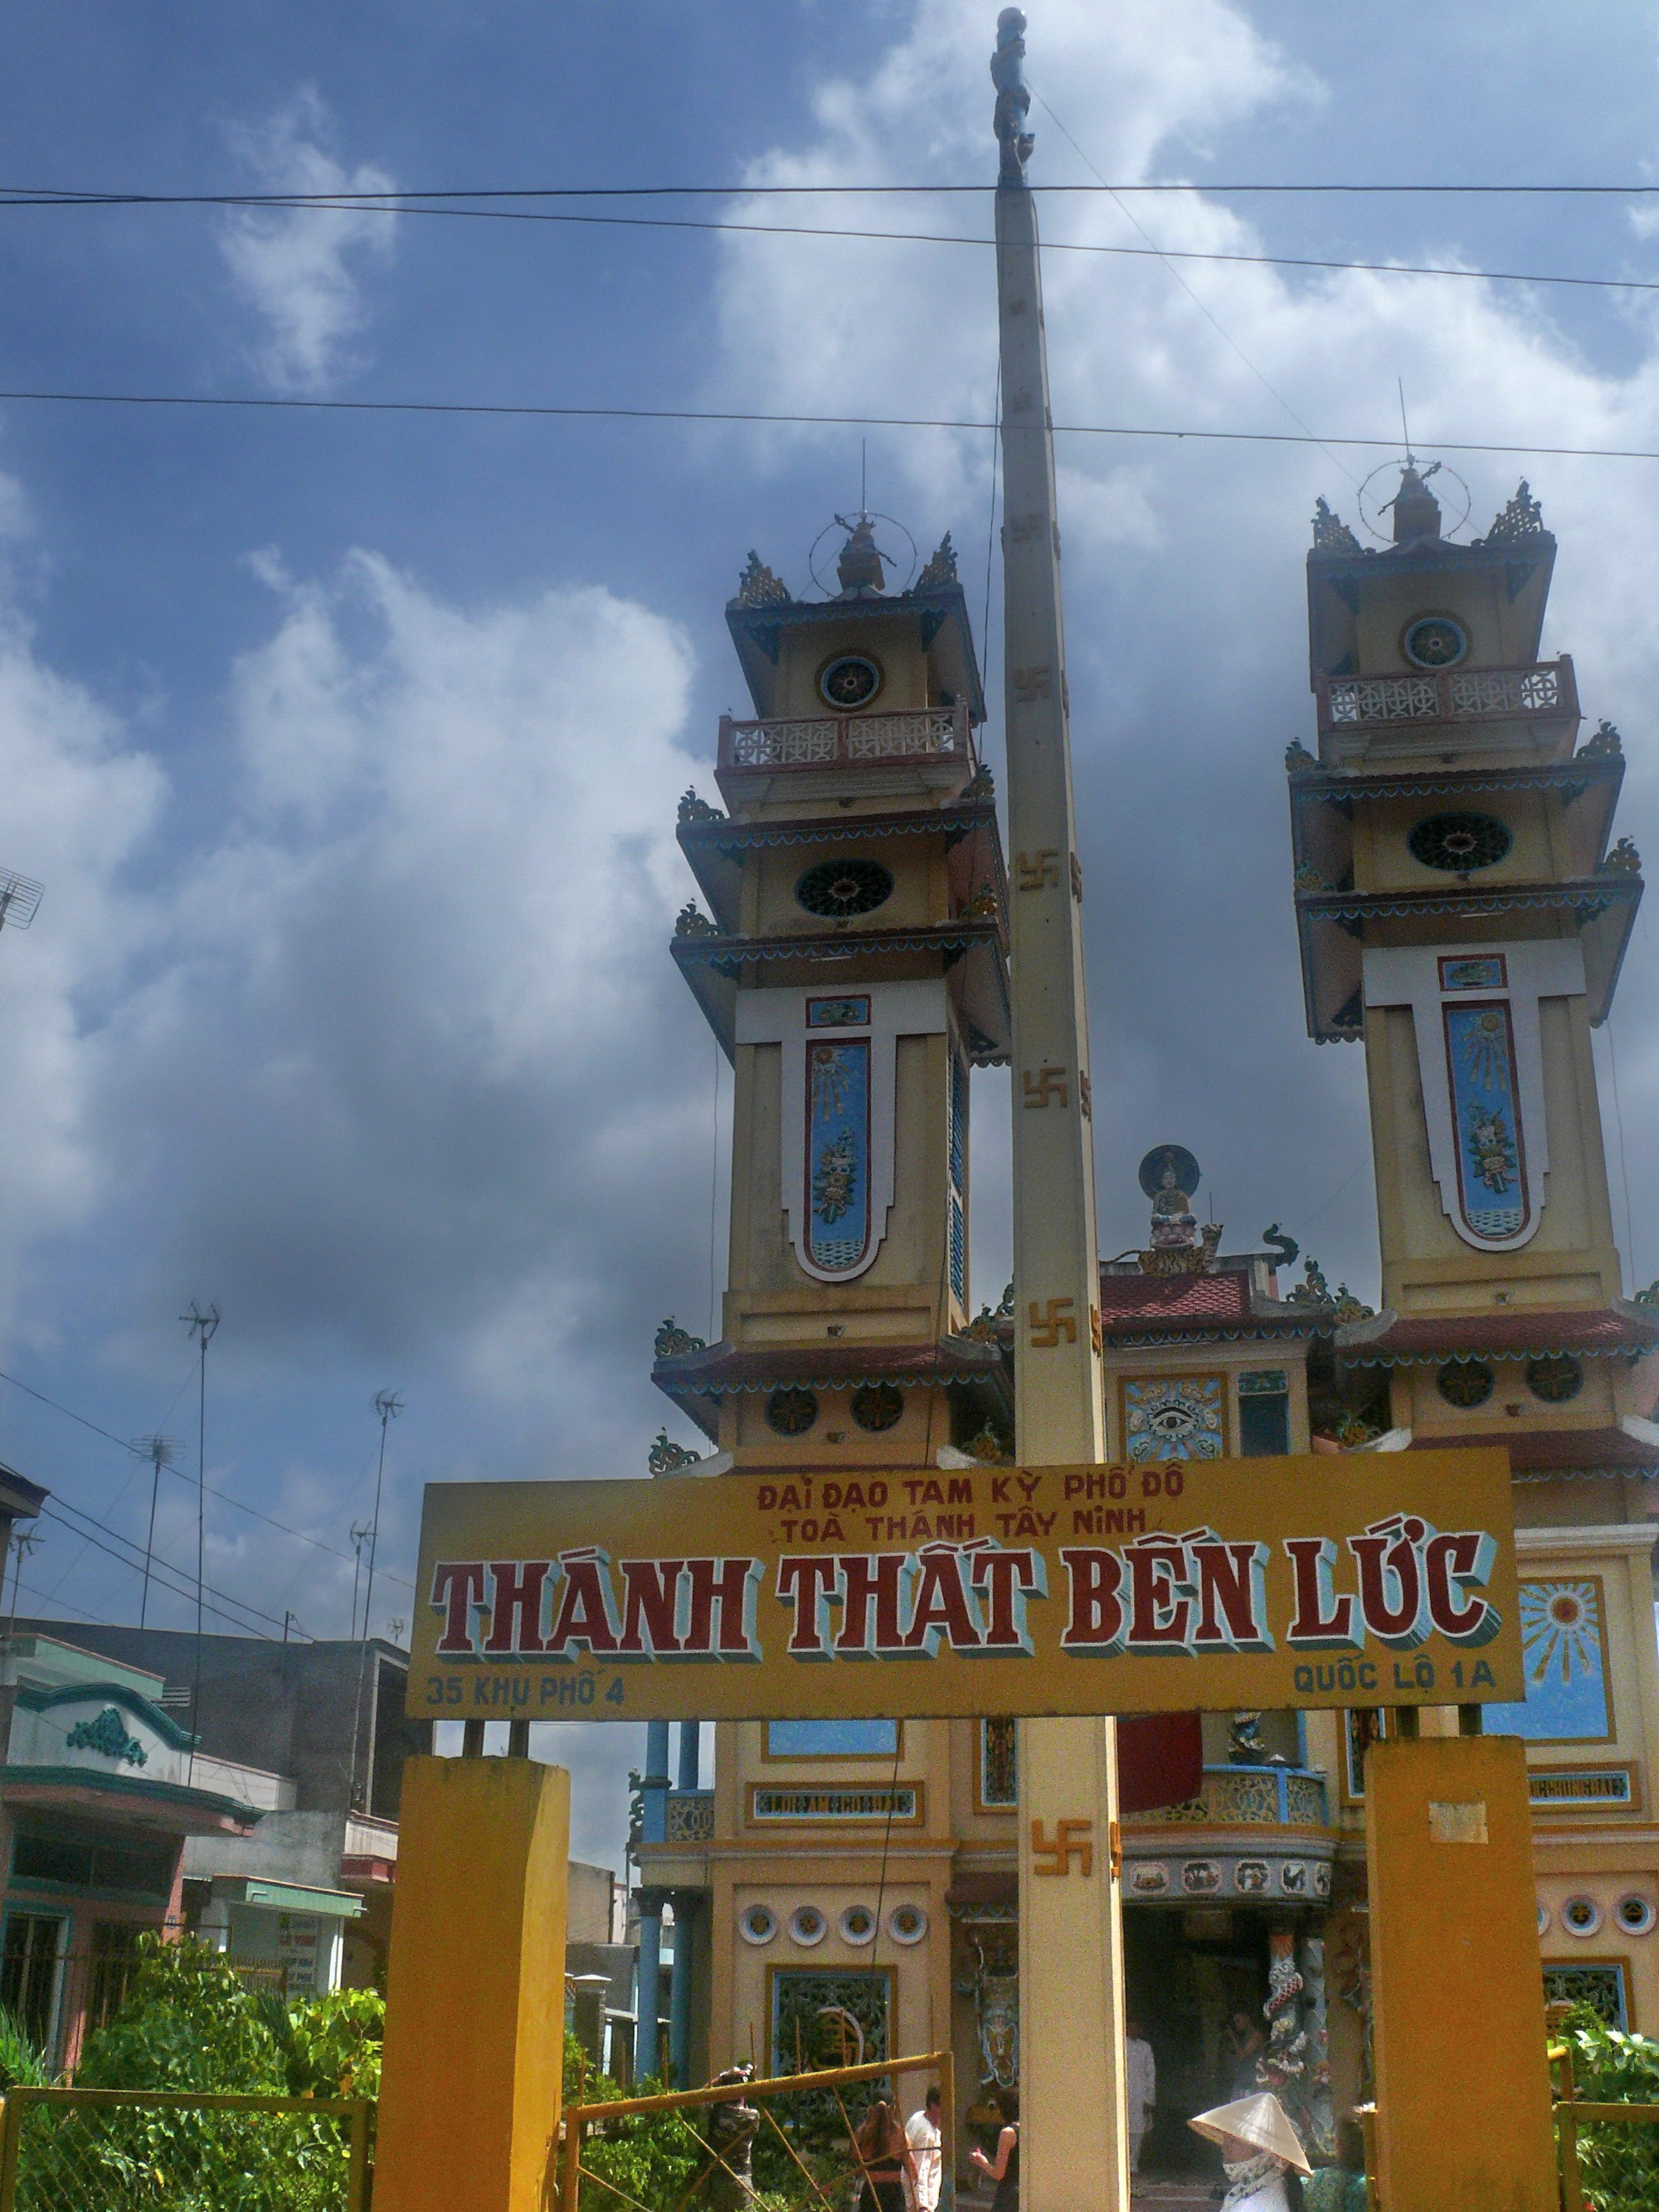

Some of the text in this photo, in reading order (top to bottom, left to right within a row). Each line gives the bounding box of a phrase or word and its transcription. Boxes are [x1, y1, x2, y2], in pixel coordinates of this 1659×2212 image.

[821, 1480, 888, 1513] ĐẠO
[902, 1478, 972, 1505] TAM
[991, 1470, 1042, 1503] KỲ
[780, 1511, 845, 1544] TOÀ
[865, 1509, 975, 1542] THÁNH
[995, 1505, 1058, 1539] TÂY
[429, 1512, 1502, 1663] THÁNH THẤT BẾN LỨC
[426, 1670, 625, 1706] 35 KHU PHỐ 4
[1293, 1653, 1378, 1694] QUỐC
[1451, 1660, 1496, 1689] 1A
